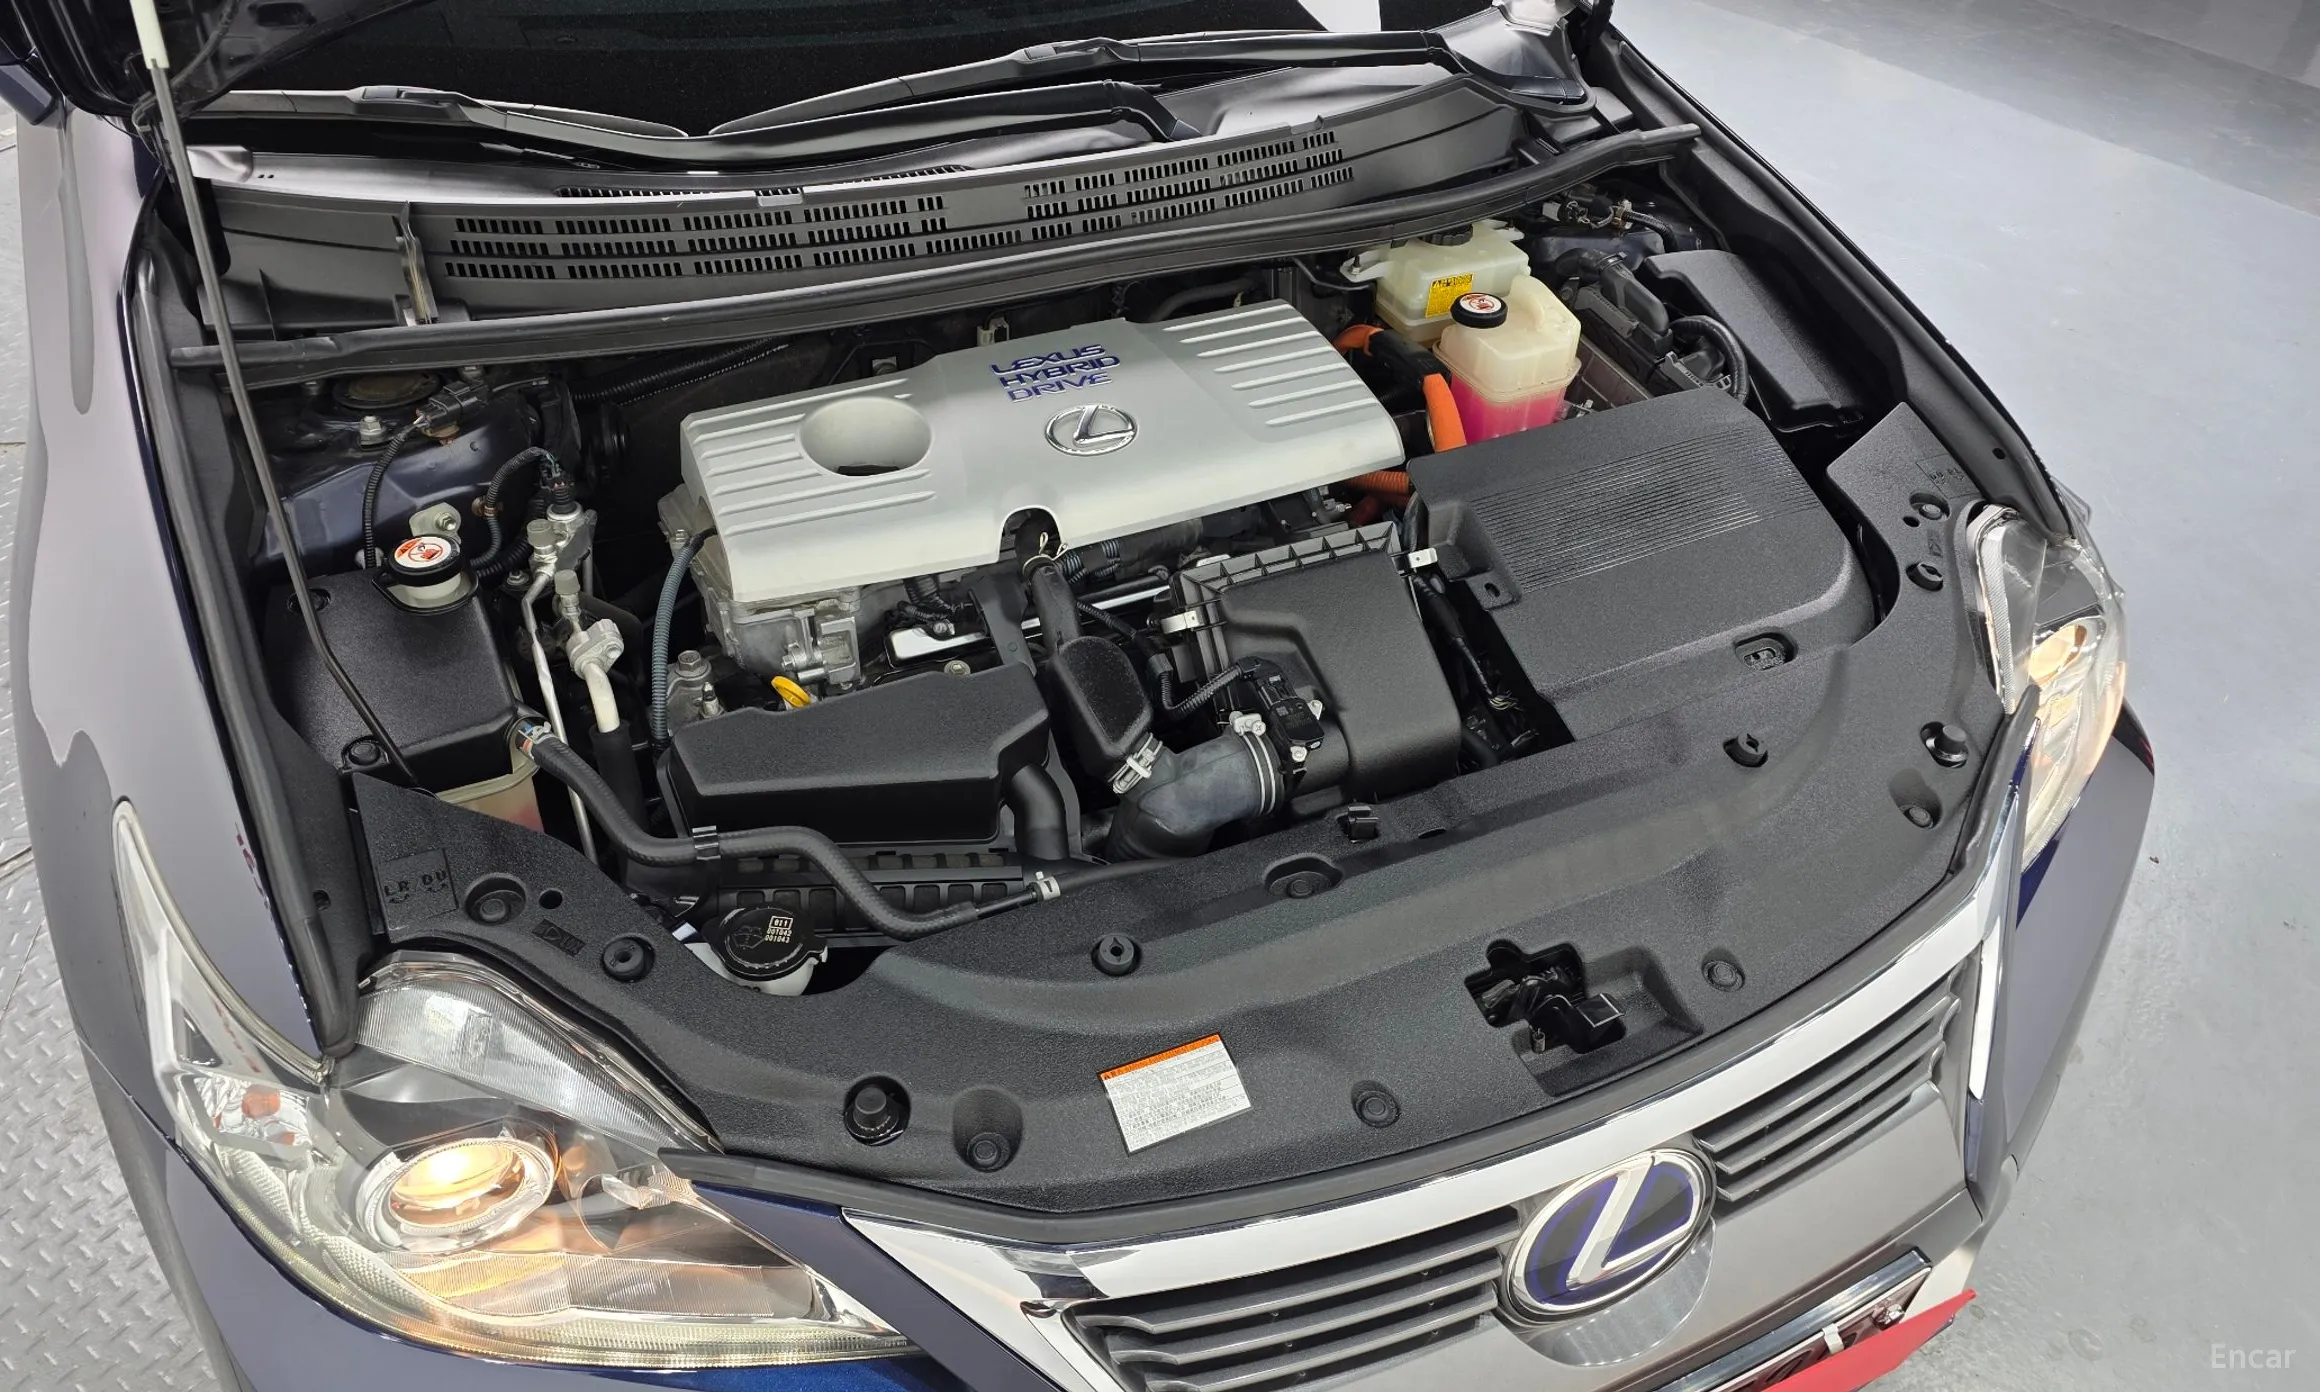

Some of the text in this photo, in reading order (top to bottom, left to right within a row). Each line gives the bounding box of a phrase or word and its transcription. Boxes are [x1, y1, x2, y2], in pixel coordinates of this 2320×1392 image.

[990, 344, 1106, 374] LEXUS
[1000, 355, 1121, 389] HYBRID
[1007, 372, 1113, 402] DRIVE
